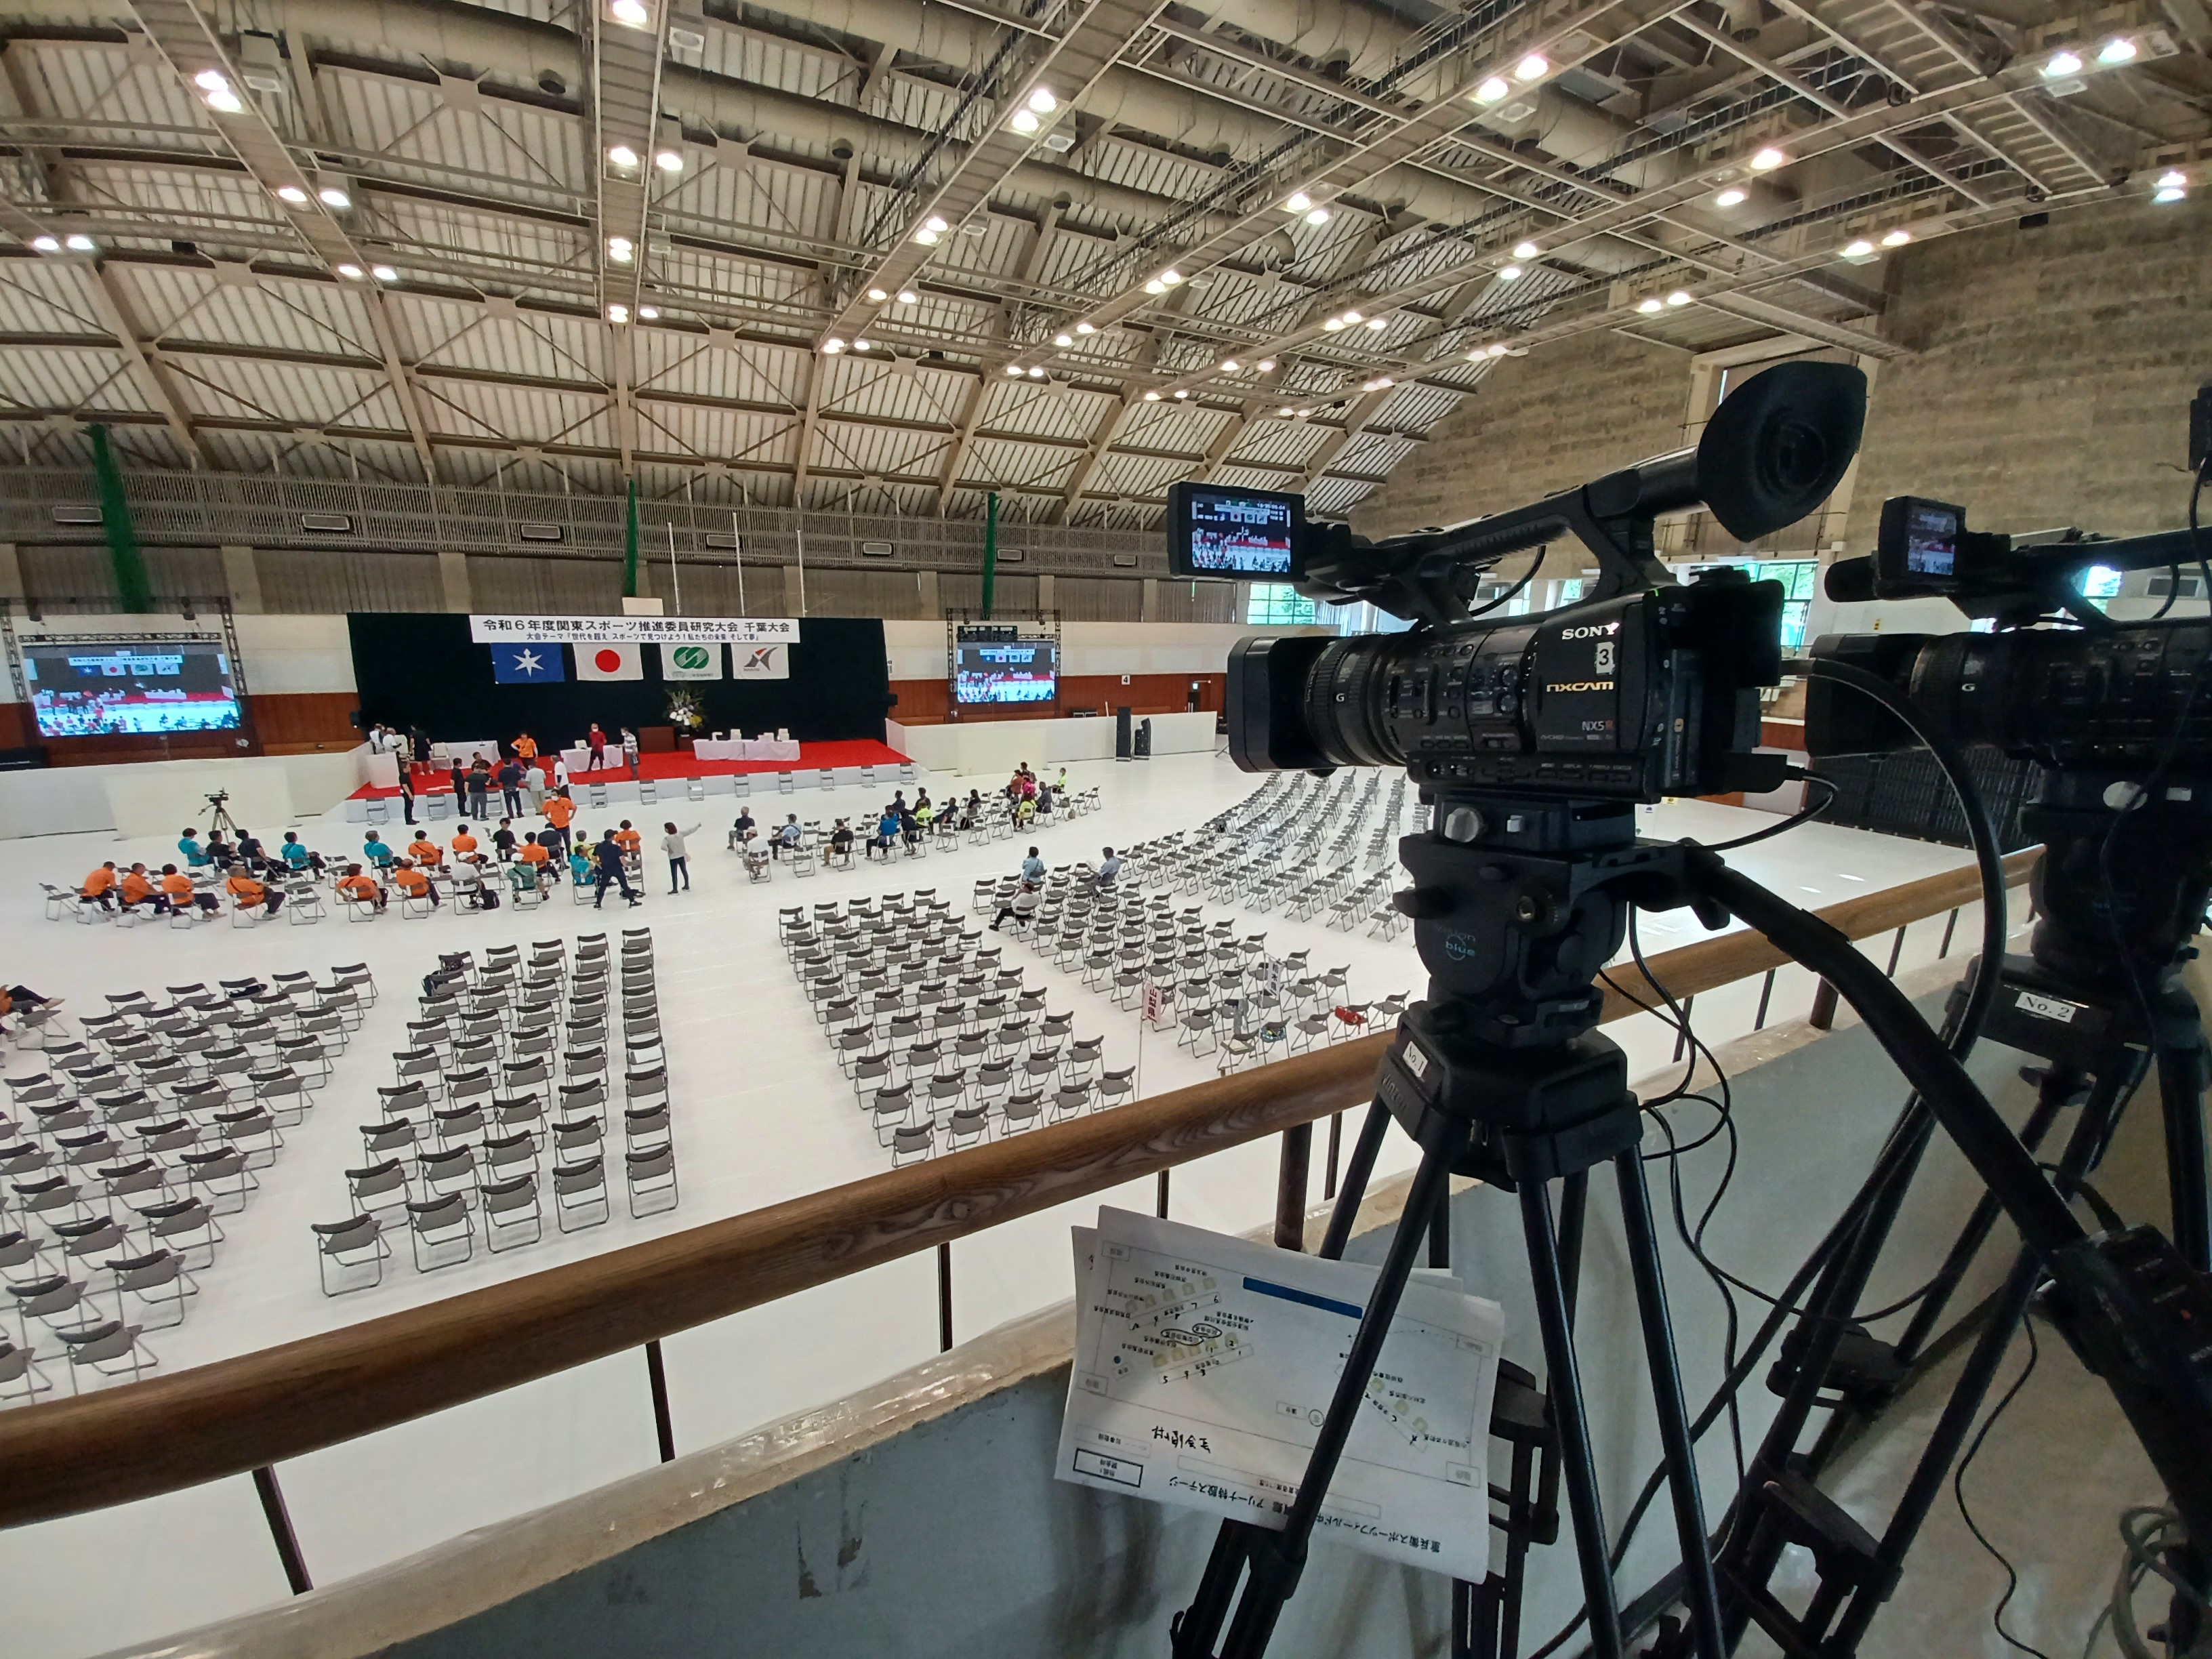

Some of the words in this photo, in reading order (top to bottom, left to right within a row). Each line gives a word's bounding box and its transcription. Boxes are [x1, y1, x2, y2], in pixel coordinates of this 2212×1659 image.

[744, 621, 790, 633] 千葉大会
[1561, 622, 1620, 640] SONY
[1599, 649, 1610, 666] 3
[1961, 683, 1976, 692] G
[1336, 693, 1345, 702] G
[1446, 941, 1475, 957] blue
